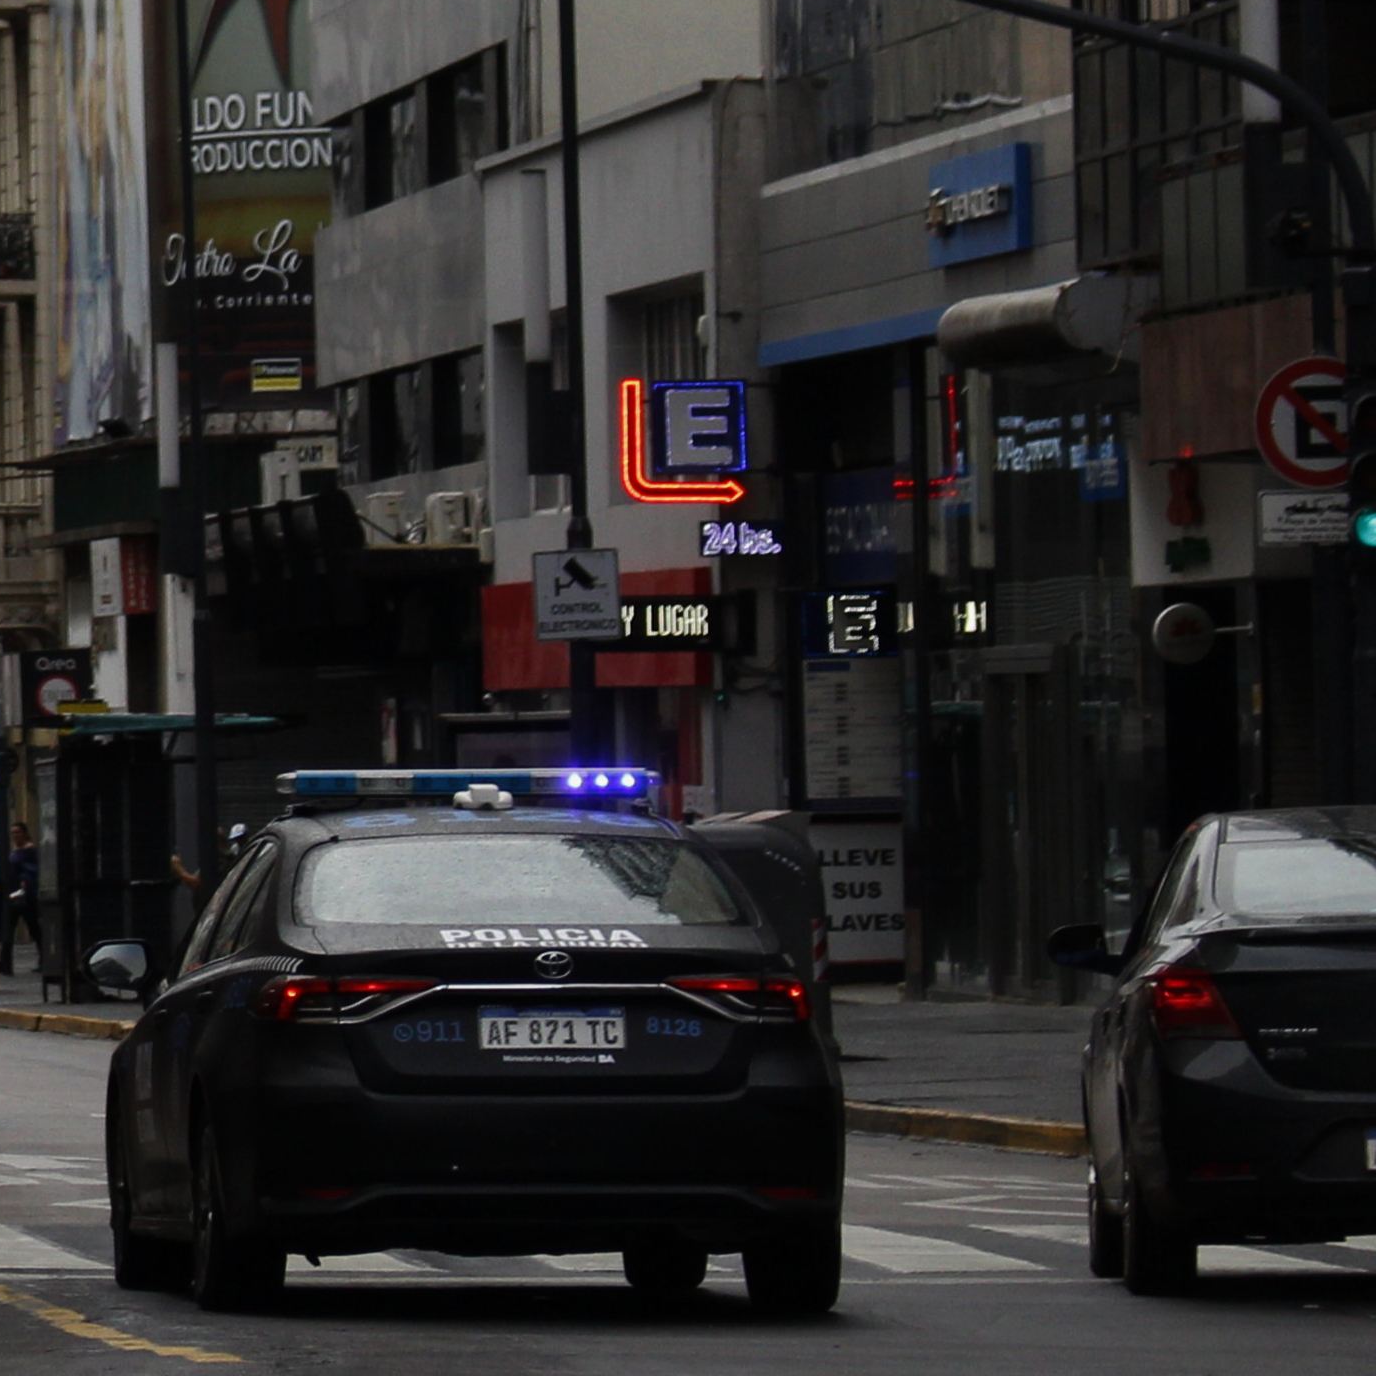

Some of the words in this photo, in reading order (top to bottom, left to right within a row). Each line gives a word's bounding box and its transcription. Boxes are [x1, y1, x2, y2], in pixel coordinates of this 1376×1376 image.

[242, 219, 303, 292] La
[663, 387, 734, 467] E
[703, 522, 735, 556] 24
[552, 603, 603, 616] CONTROL
[541, 619, 617, 633] ELECTRONICO
[645, 604, 709, 638] LUGAR
[818, 848, 896, 867] LLEVE
[832, 880, 882, 900] SUS
[439, 928, 644, 943] POLICIA
[417, 1021, 466, 1043] 911
[487, 1020, 518, 1045] AF
[528, 1020, 577, 1045] 871
[587, 1020, 618, 1045] TC
[646, 1016, 703, 1037] 8126
[502, 1054, 542, 1064] Ministerio
[543, 1055, 554, 1063] de
[555, 1054, 596, 1065] Seguridad
